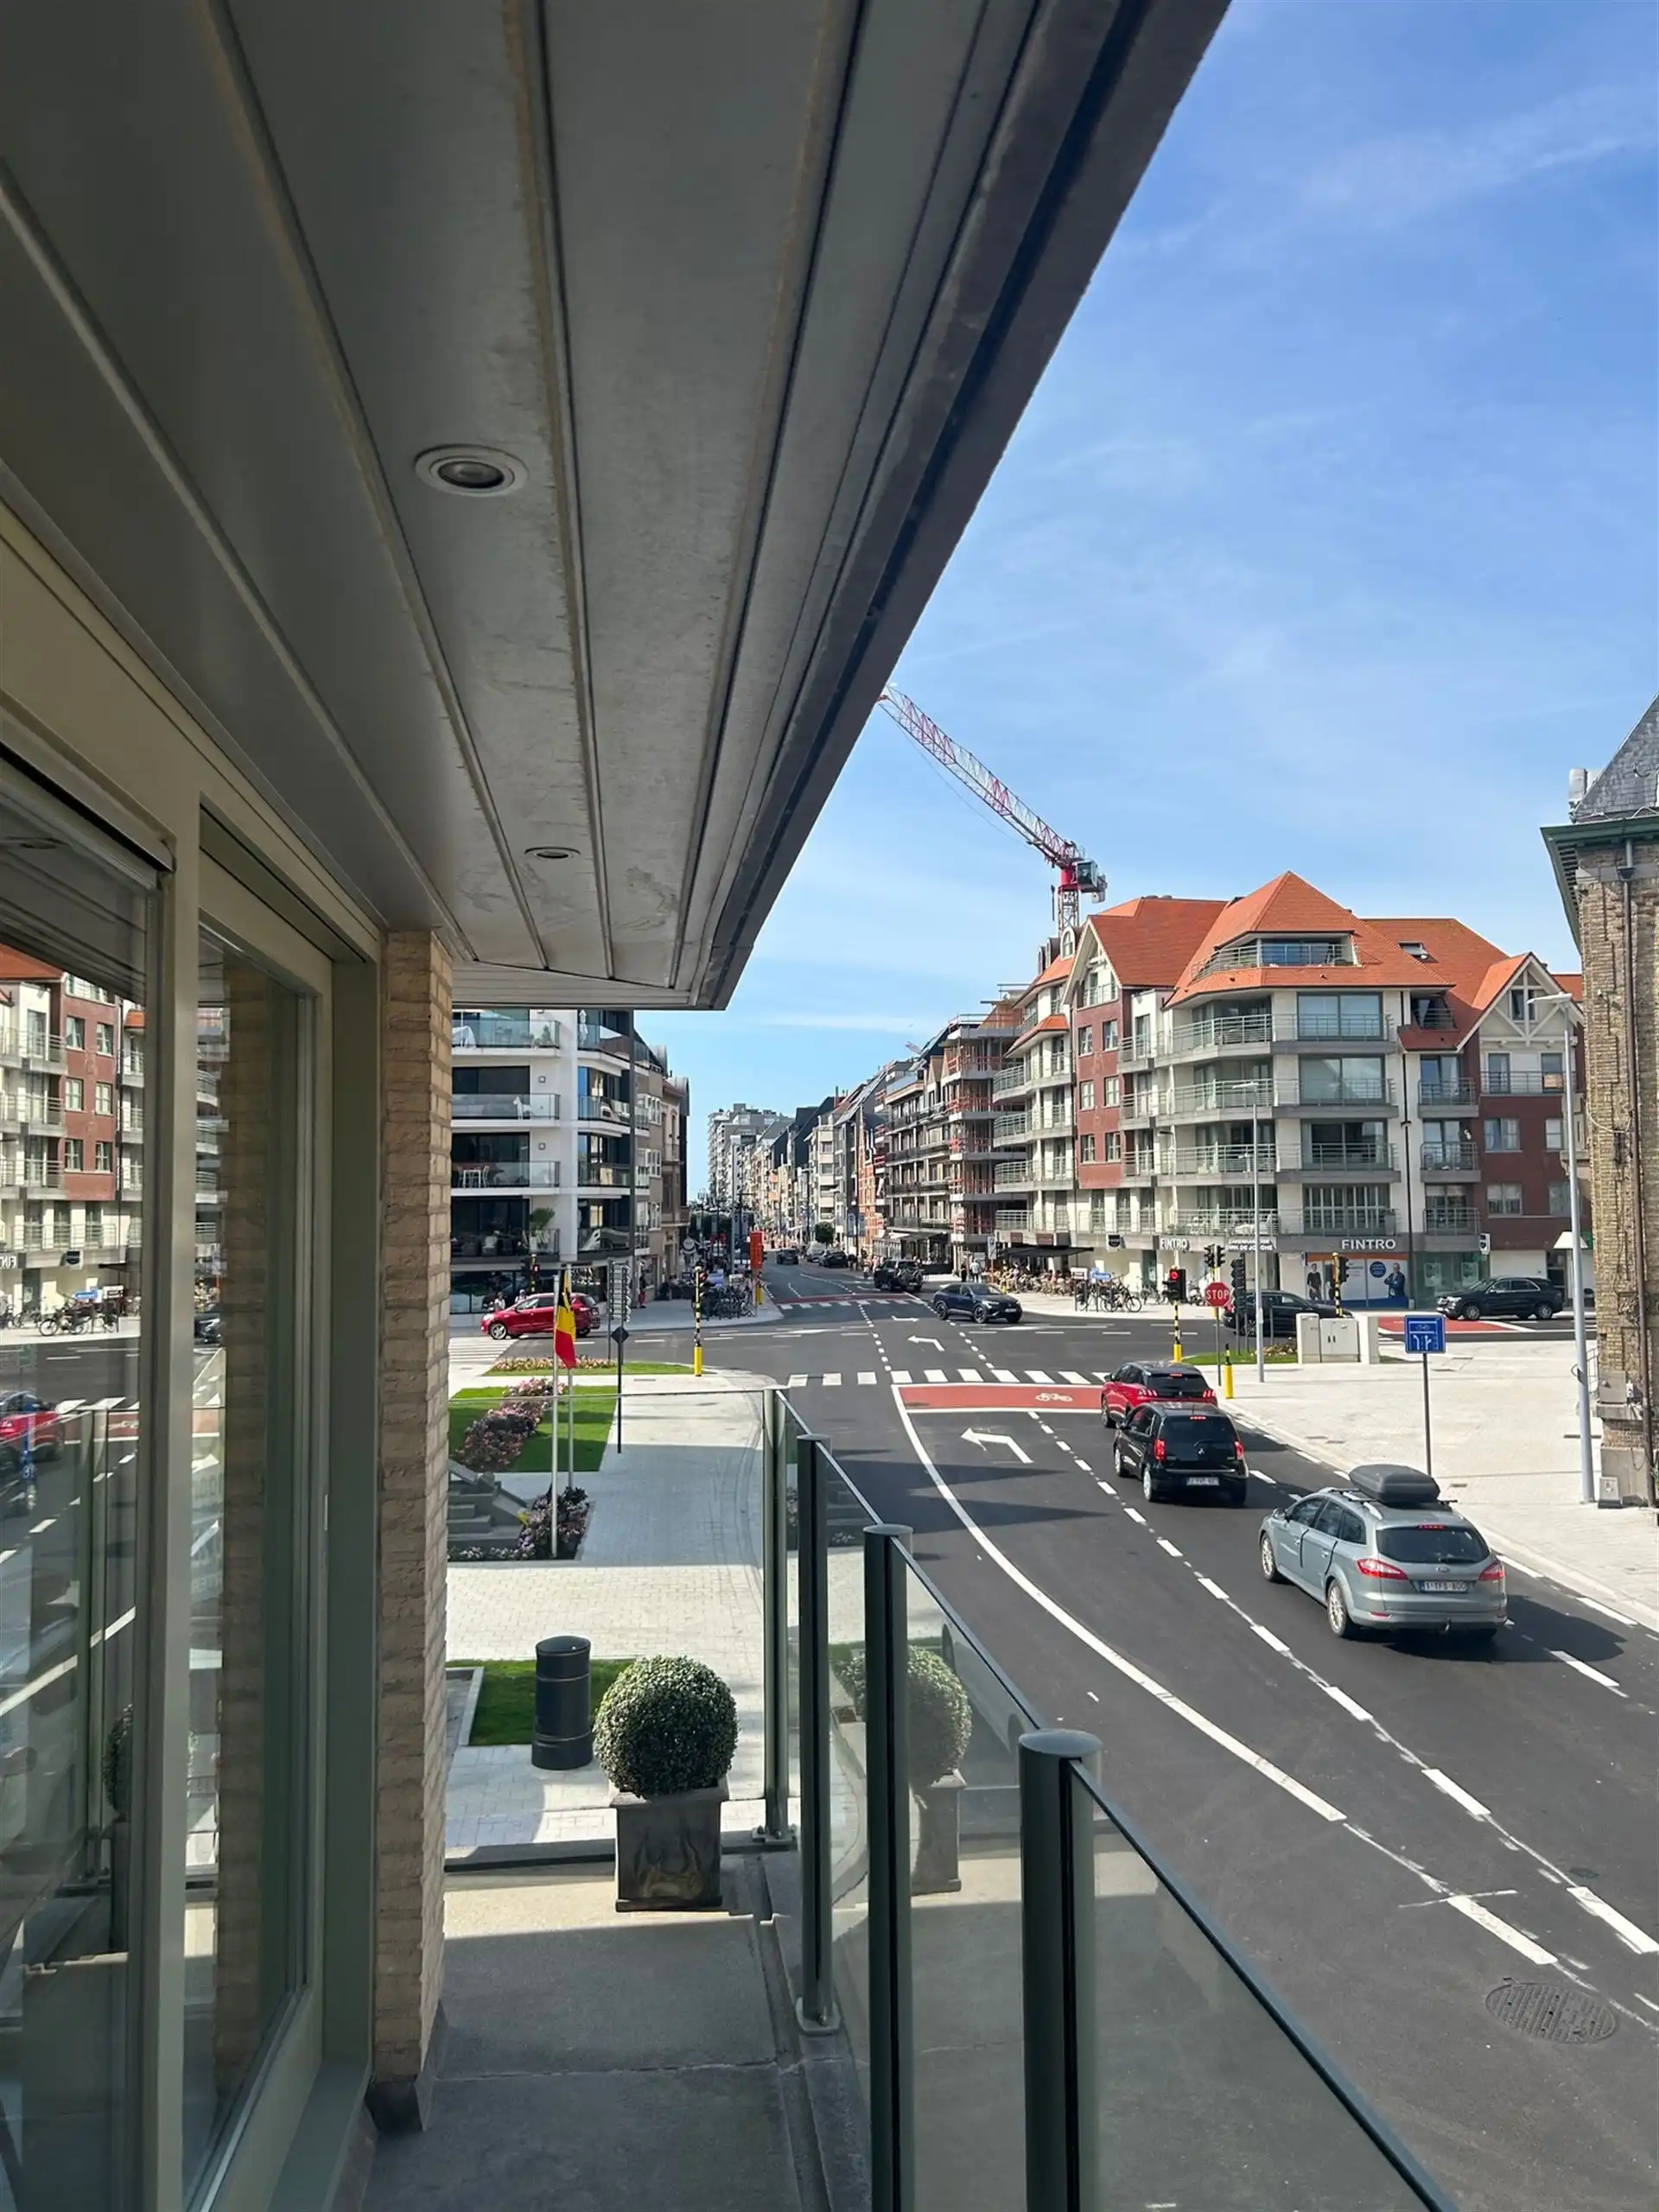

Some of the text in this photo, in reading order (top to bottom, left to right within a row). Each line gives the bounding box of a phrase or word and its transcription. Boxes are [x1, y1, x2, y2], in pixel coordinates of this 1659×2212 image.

[1160, 1238, 1187, 1250] FINTRO
[1341, 1238, 1396, 1250] FINTRO
[1205, 1289, 1229, 1300] STOP
